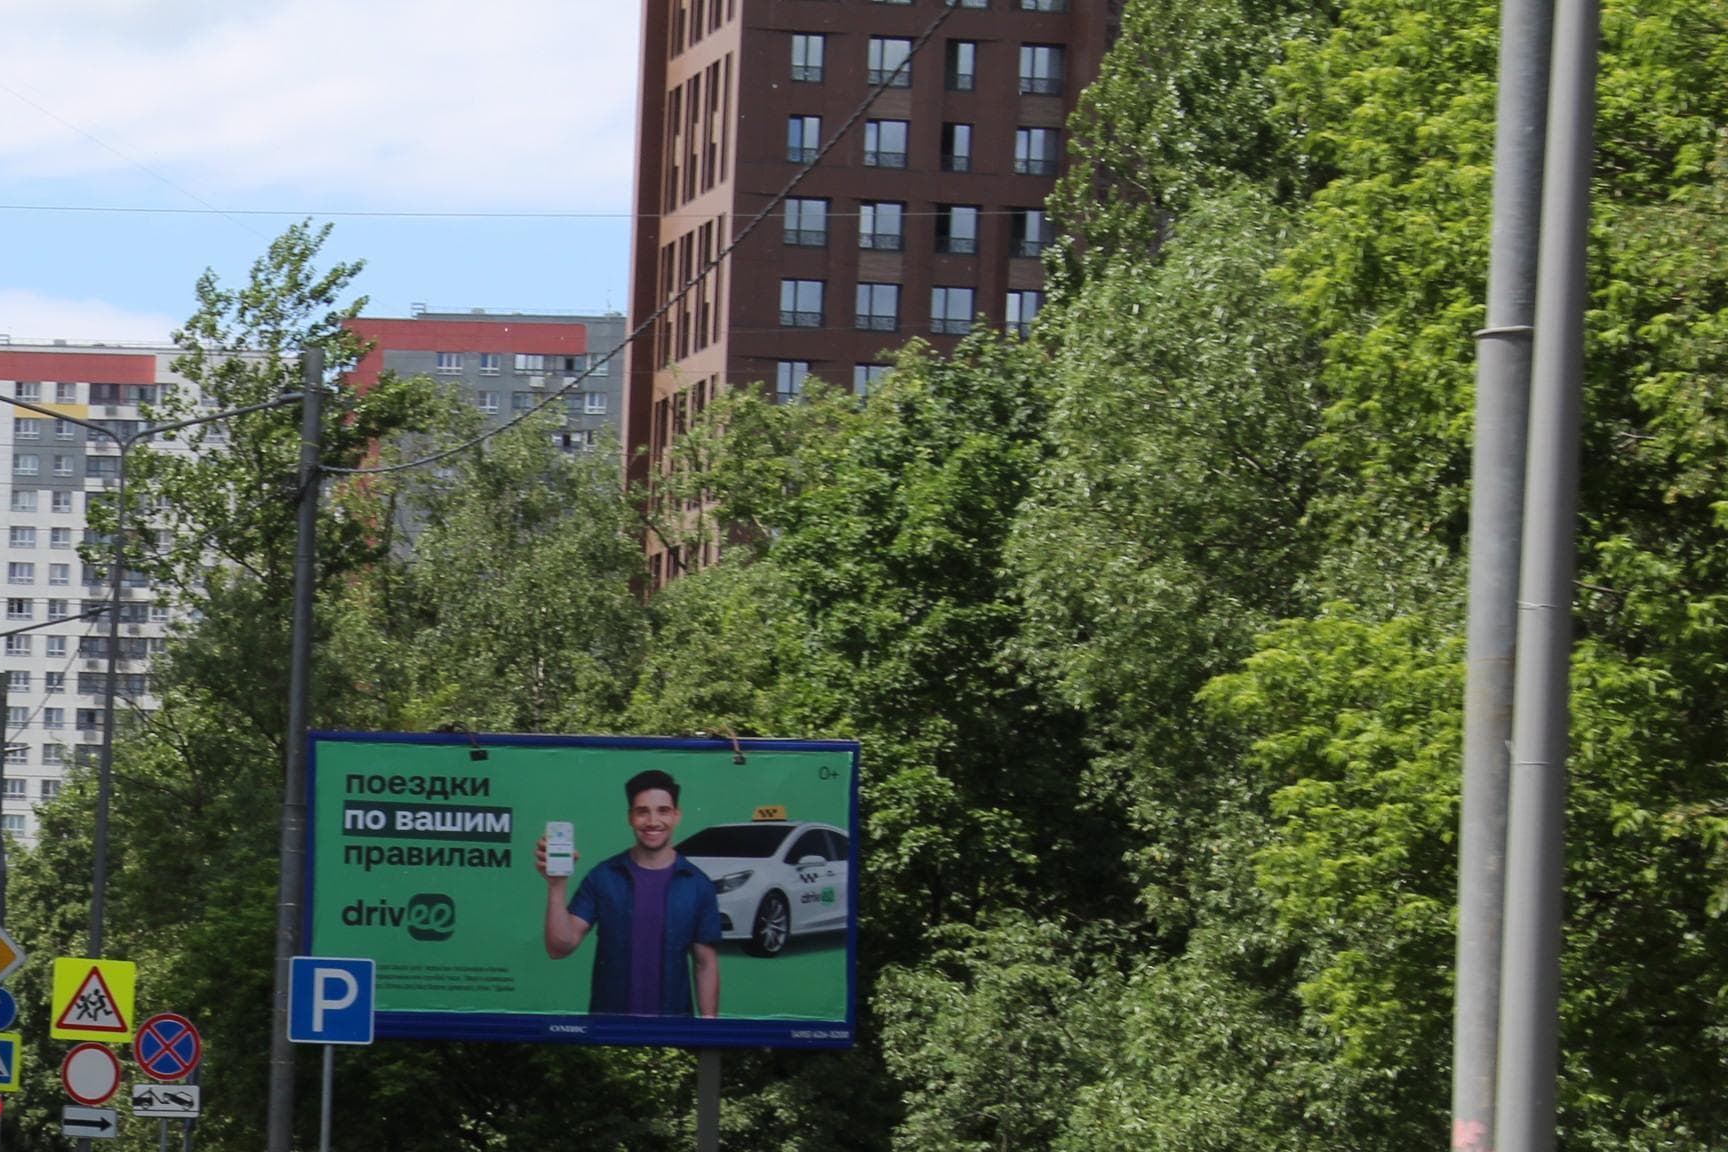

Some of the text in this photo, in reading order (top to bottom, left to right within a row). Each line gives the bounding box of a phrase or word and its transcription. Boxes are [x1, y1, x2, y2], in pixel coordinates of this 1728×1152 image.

[345, 773, 490, 800] поездки
[344, 808, 511, 833] по вашим
[344, 845, 512, 872] правилам
[313, 968, 358, 1032] P
